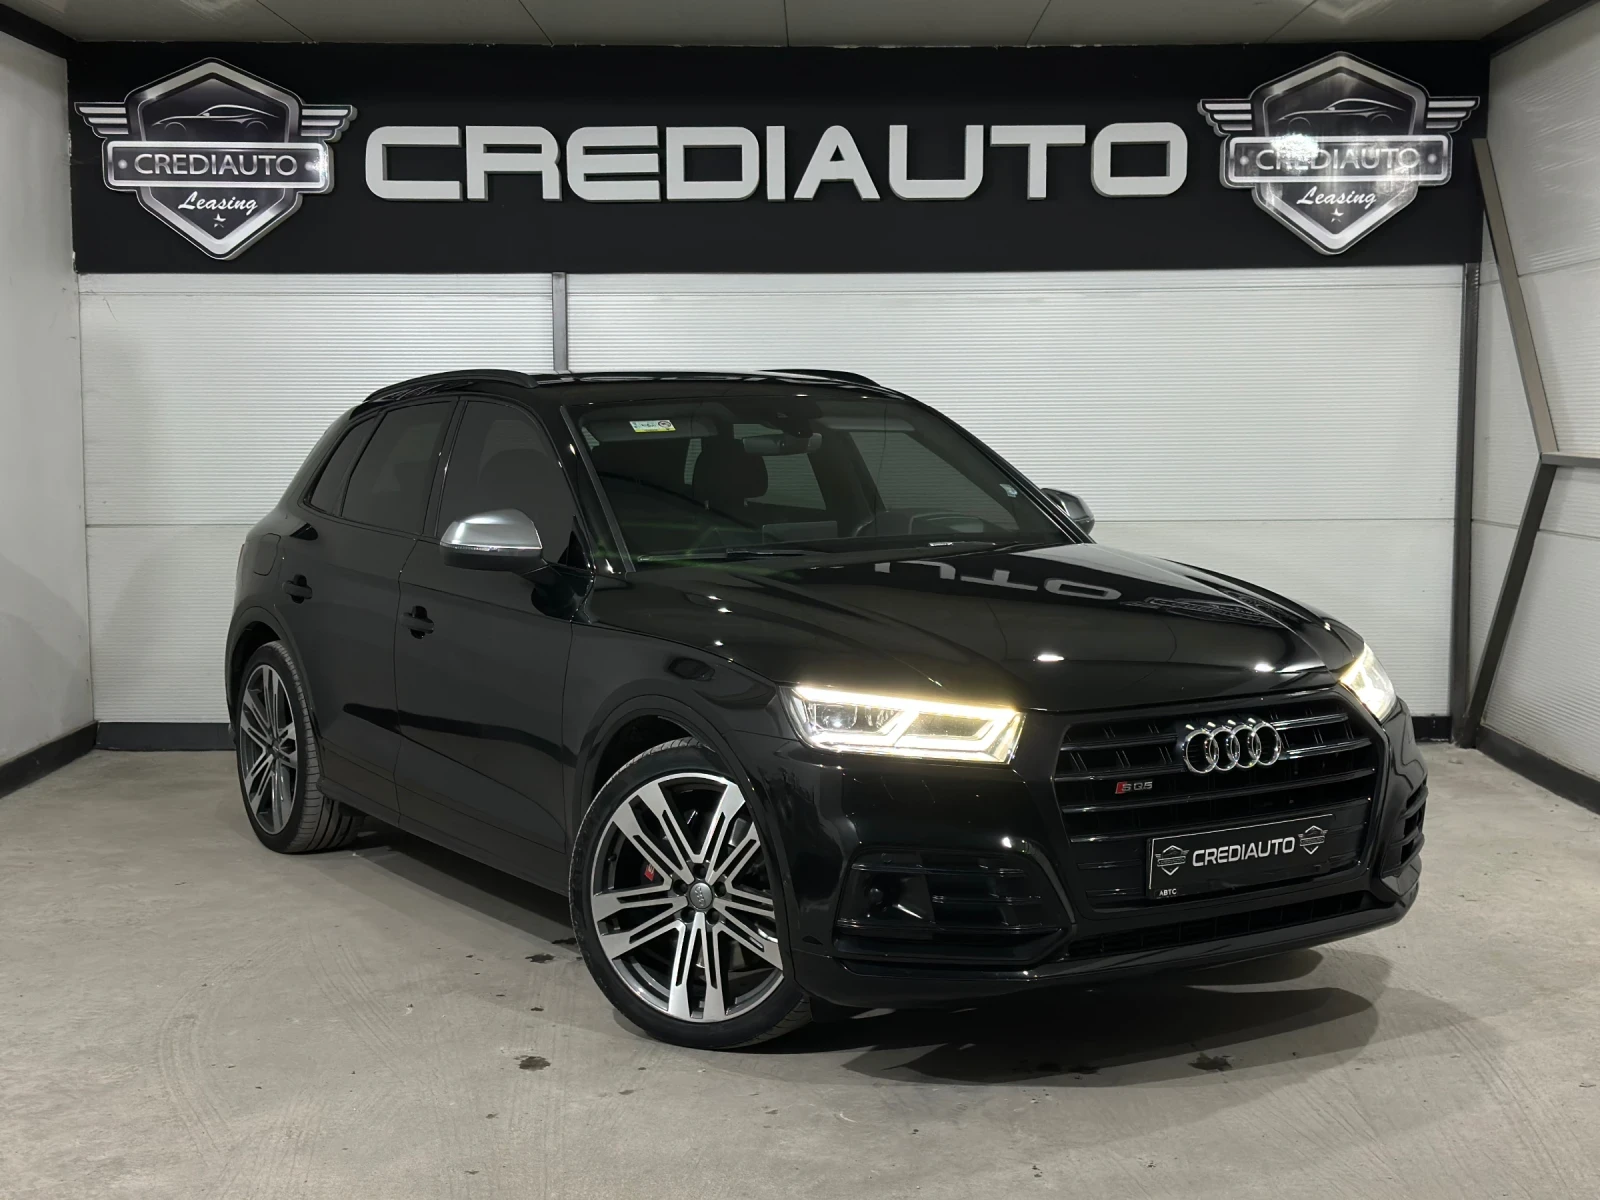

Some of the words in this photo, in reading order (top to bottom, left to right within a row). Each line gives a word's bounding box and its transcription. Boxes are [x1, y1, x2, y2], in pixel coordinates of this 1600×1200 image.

[134, 153, 298, 176] CREDIAUTO
[365, 121, 1188, 202] CREDIAUTO
[177, 190, 259, 216] Leasing
[1295, 185, 1377, 210] Leasing
[1192, 836, 1296, 867] CREDIAUTO
